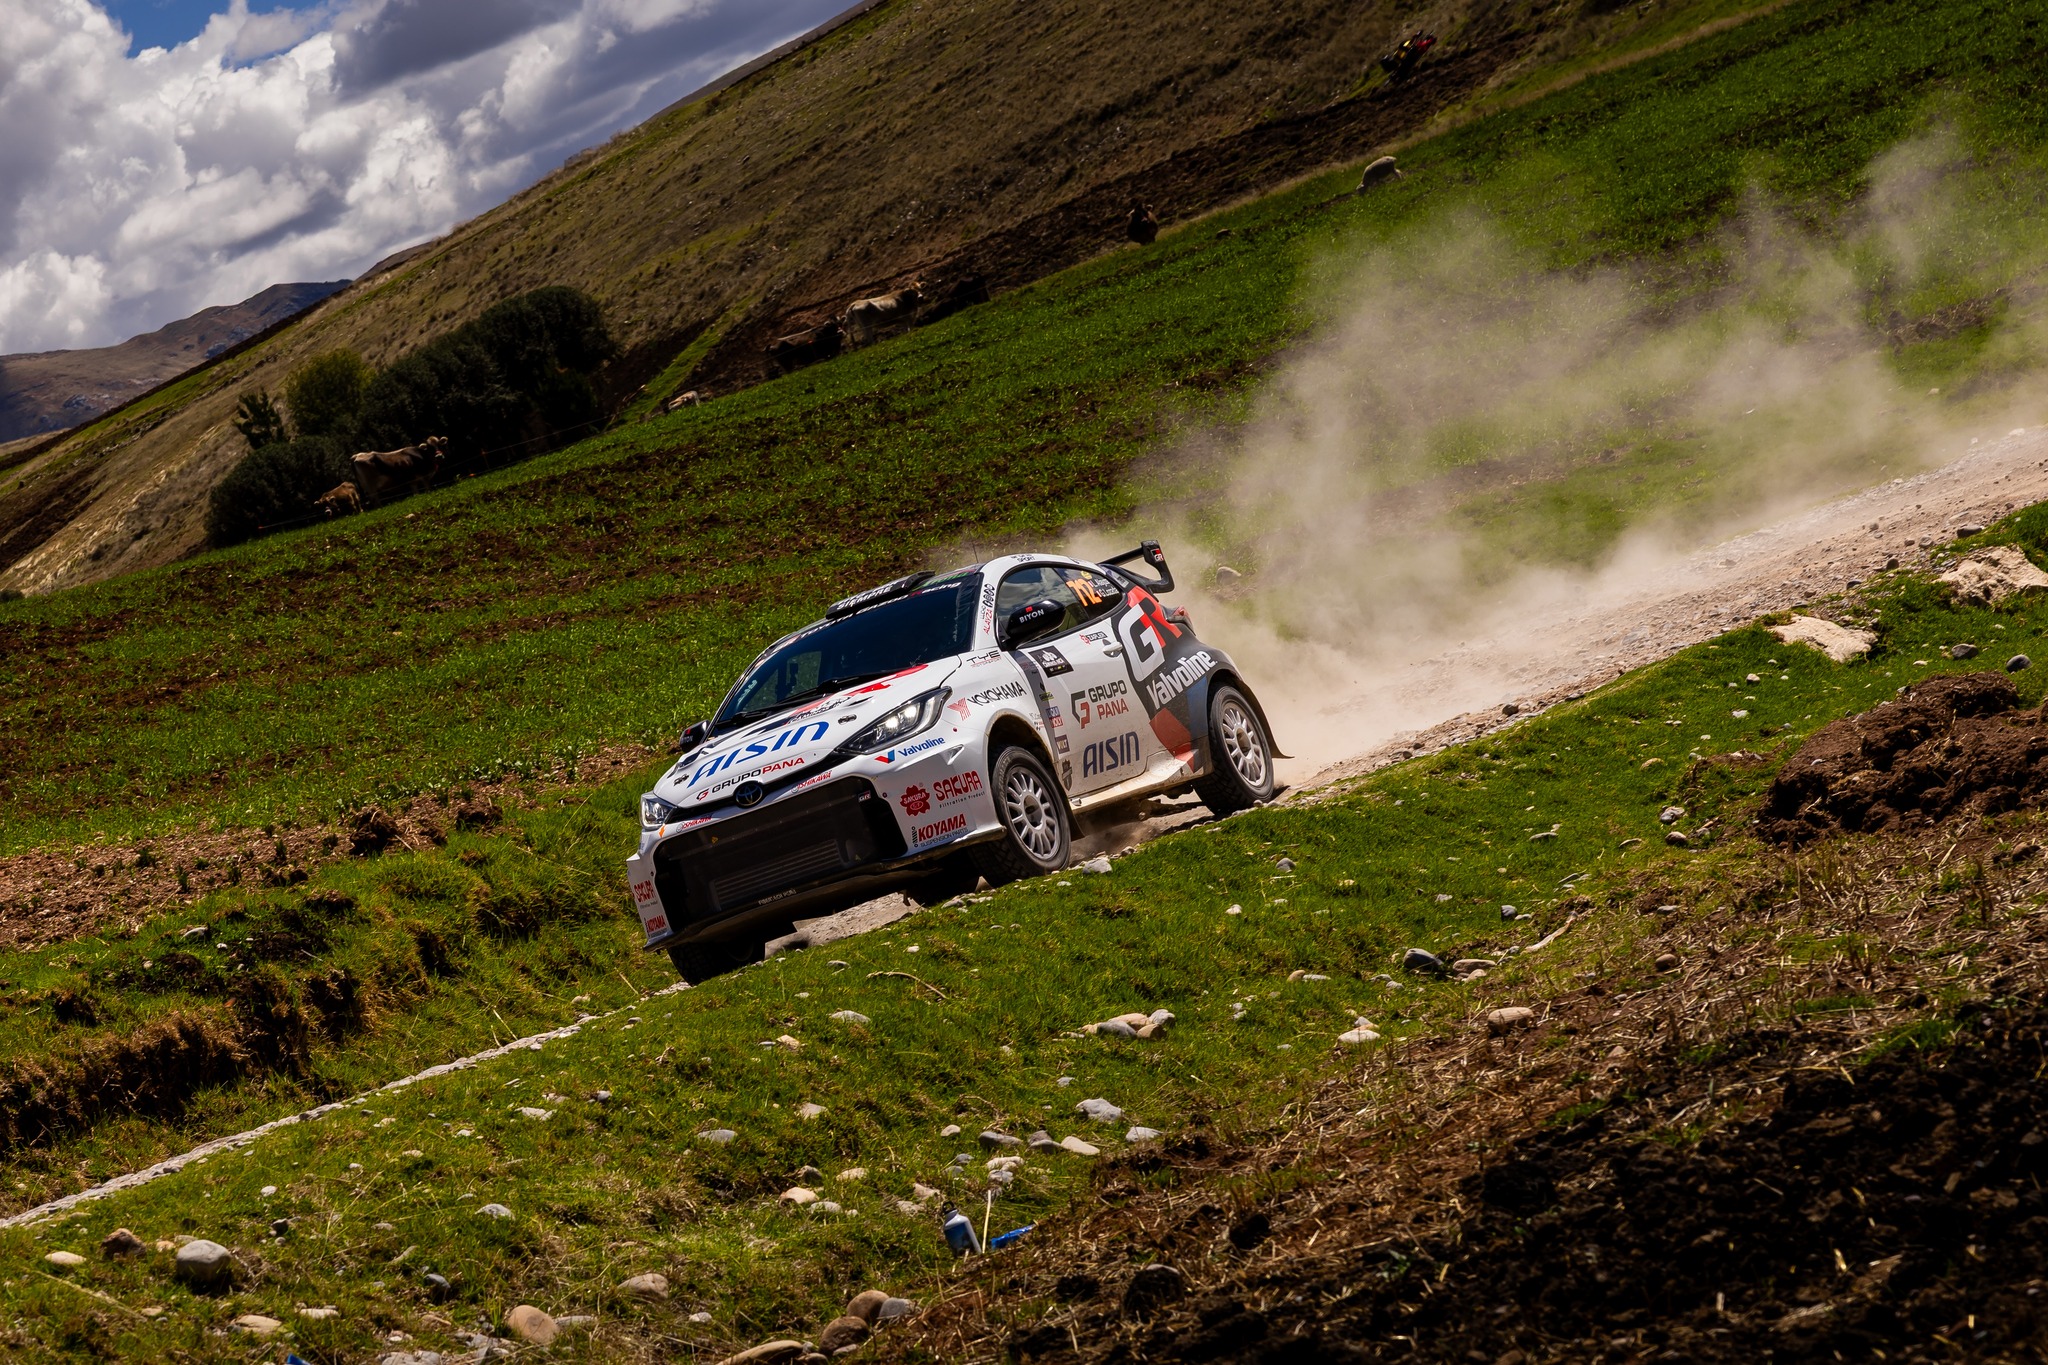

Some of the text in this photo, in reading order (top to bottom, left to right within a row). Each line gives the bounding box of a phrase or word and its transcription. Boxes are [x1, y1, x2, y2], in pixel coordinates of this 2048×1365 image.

[1154, 554, 1164, 562] GR
[836, 585, 893, 610] SIEMPRE
[911, 582, 961, 597] Racing
[1066, 578, 1102, 606] 712
[983, 608, 993, 634] ALAYZA
[1019, 608, 1045, 624] BIYON
[1118, 585, 1182, 682] GR
[967, 649, 1001, 663] TYE
[1088, 679, 1127, 703] GRUPO
[1146, 650, 1216, 710] Valvoline
[967, 681, 1027, 706] YOKOHAMA
[1097, 698, 1129, 720] PANA
[687, 721, 830, 788] AISIN
[898, 737, 946, 757] Valvoline
[1083, 731, 1140, 779] AISIN
[903, 791, 927, 804] SAKURA
[933, 770, 982, 801] SAKURA
[939, 790, 986, 809] Filtration Product
[918, 813, 967, 842] KOYAMA
[920, 827, 969, 848] SUSPENSION PARTS
